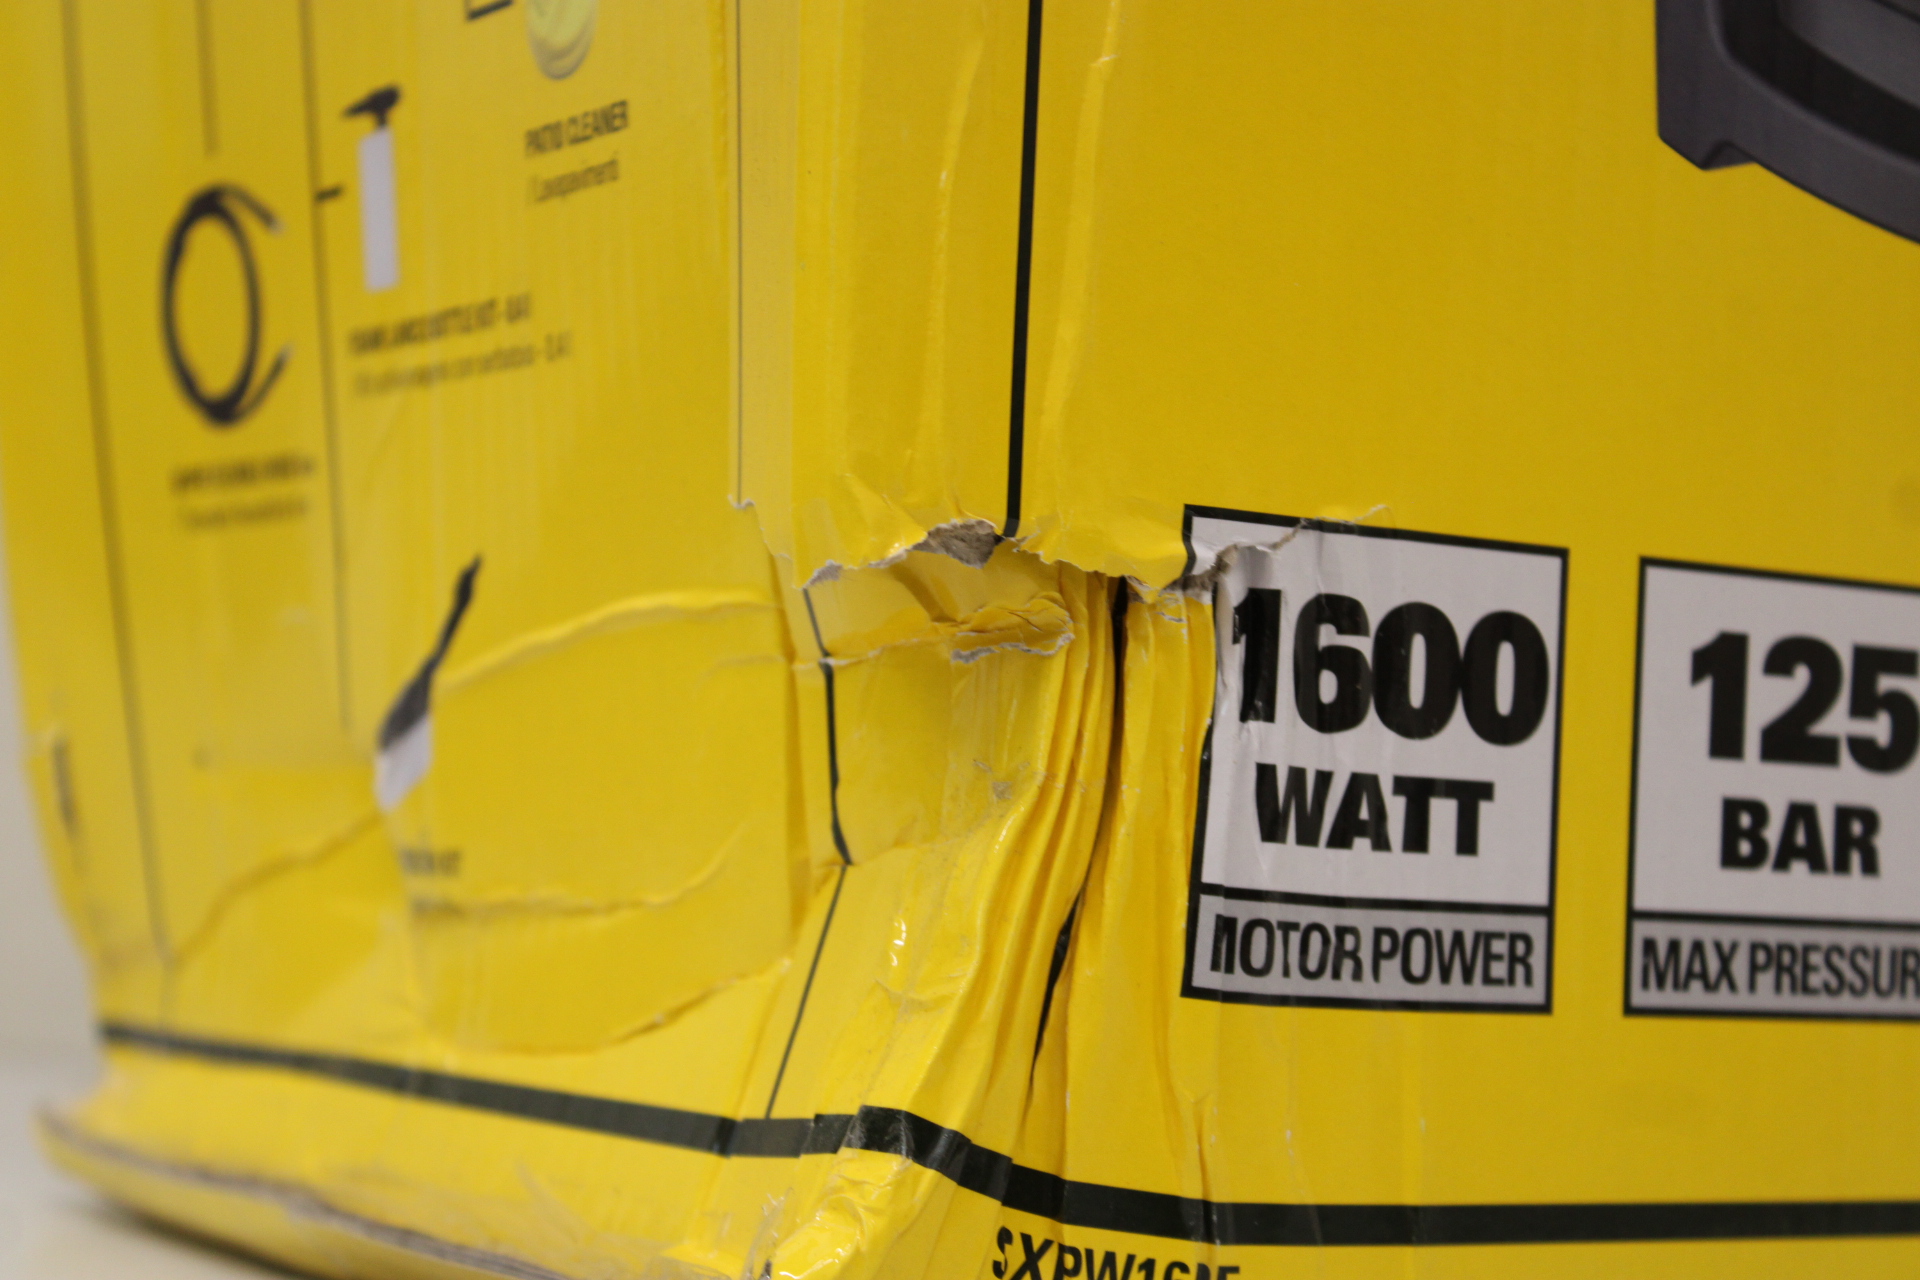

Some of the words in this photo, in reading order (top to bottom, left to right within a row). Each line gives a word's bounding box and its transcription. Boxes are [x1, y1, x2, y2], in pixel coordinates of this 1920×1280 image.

[1232, 588, 1549, 746] 1600
[1691, 629, 1920, 775] 125
[1256, 763, 1494, 857] WATT
[1720, 797, 1880, 877] BAR
[1372, 926, 1534, 988] POWER
[1641, 937, 1738, 992] MAX
[992, 1225, 1240, 1280] SXPW
